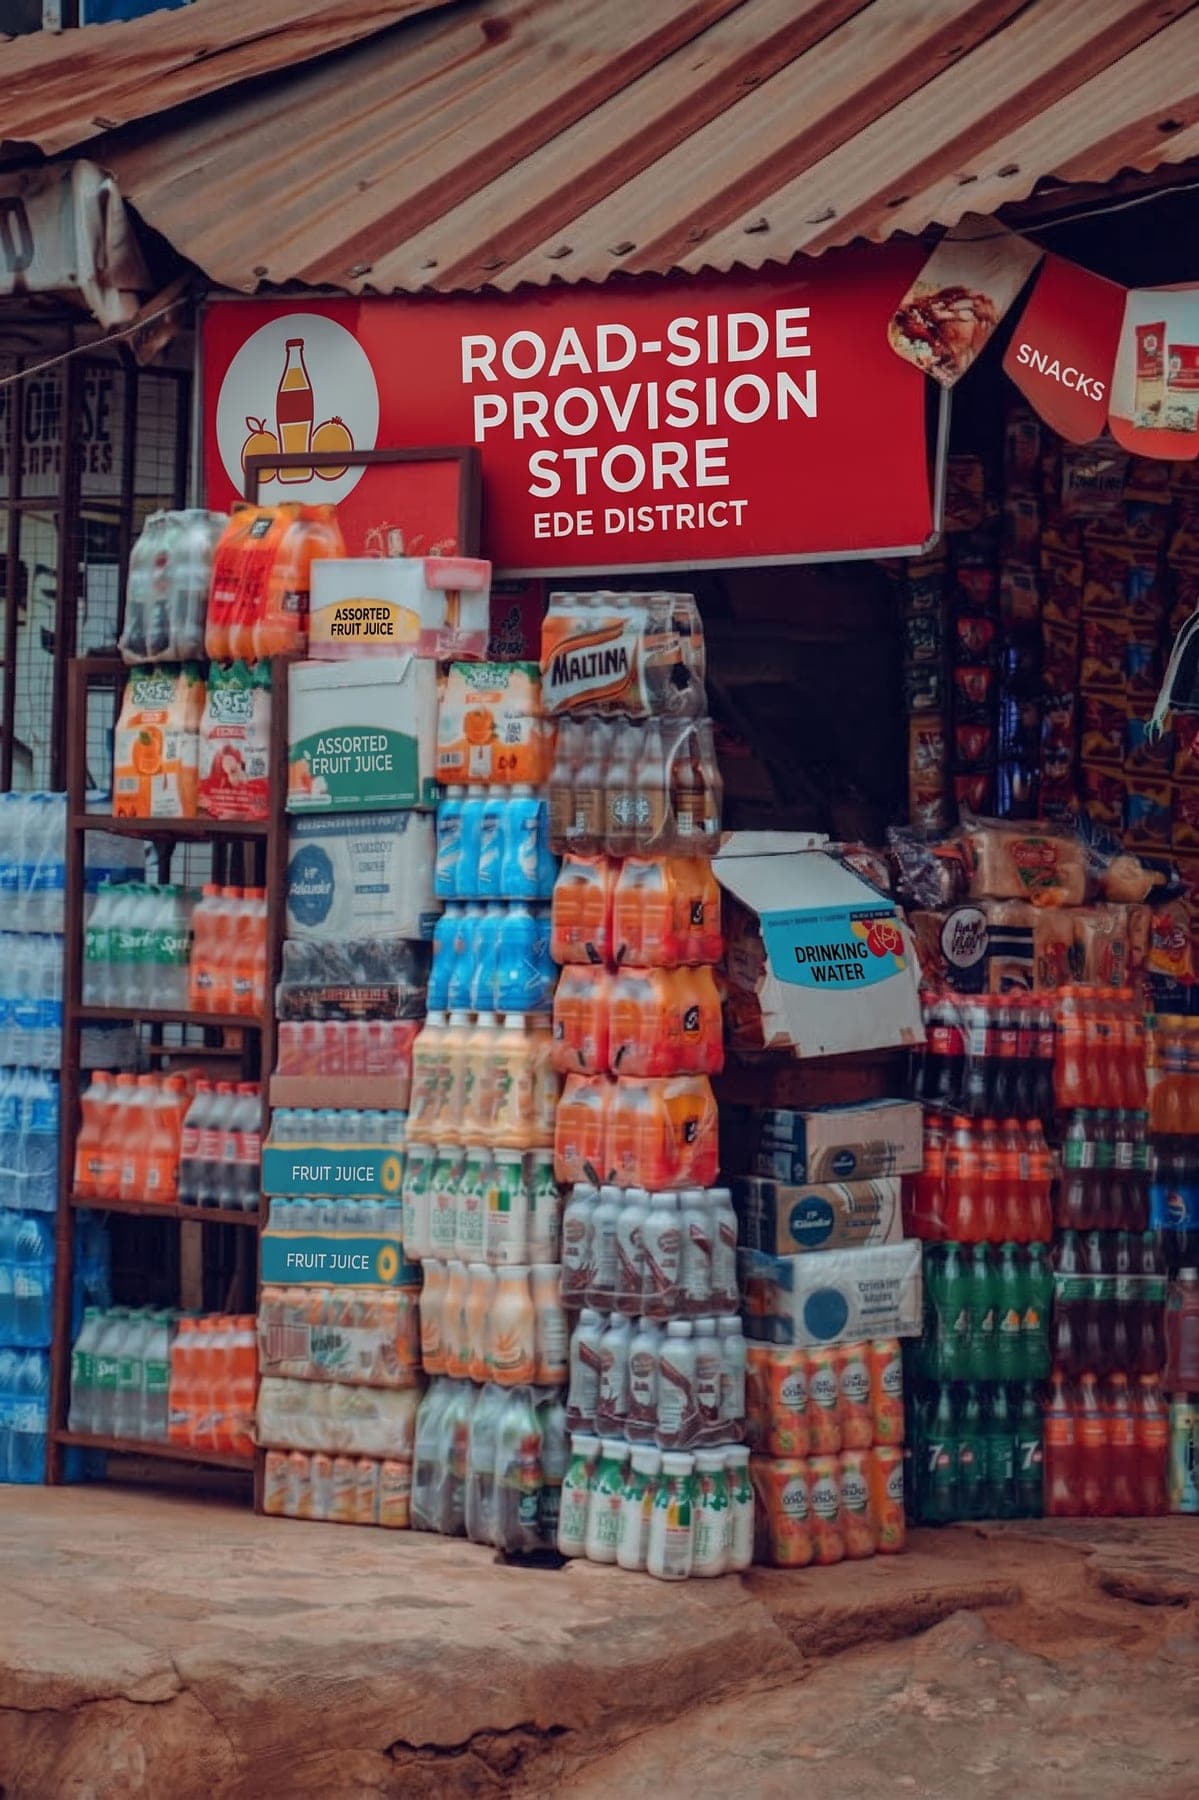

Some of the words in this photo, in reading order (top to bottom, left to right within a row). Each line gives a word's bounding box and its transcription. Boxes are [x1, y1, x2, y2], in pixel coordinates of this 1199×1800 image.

[461, 307, 811, 385] ROAD-SIDE
[1016, 342, 1107, 403] SNACKS
[473, 369, 817, 443] PROVISION
[528, 437, 730, 498] STORE
[534, 509, 595, 539] EDE
[604, 499, 749, 534] DISTRICT
[334, 607, 391, 622] ASSORTED
[330, 622, 362, 637] FRUIT
[362, 622, 394, 636] JUICE
[551, 646, 628, 688] MALTINA
[316, 734, 388, 755] ASSORTED
[312, 756, 351, 775] FRUIT
[354, 754, 393, 773] JUICE
[794, 941, 868, 964] DRINKING
[811, 963, 866, 982] WATER
[292, 1165, 332, 1182] FRUIT
[334, 1165, 375, 1183] JUICE
[286, 1253, 328, 1269] FRUIT
[329, 1254, 370, 1270] JUICE
